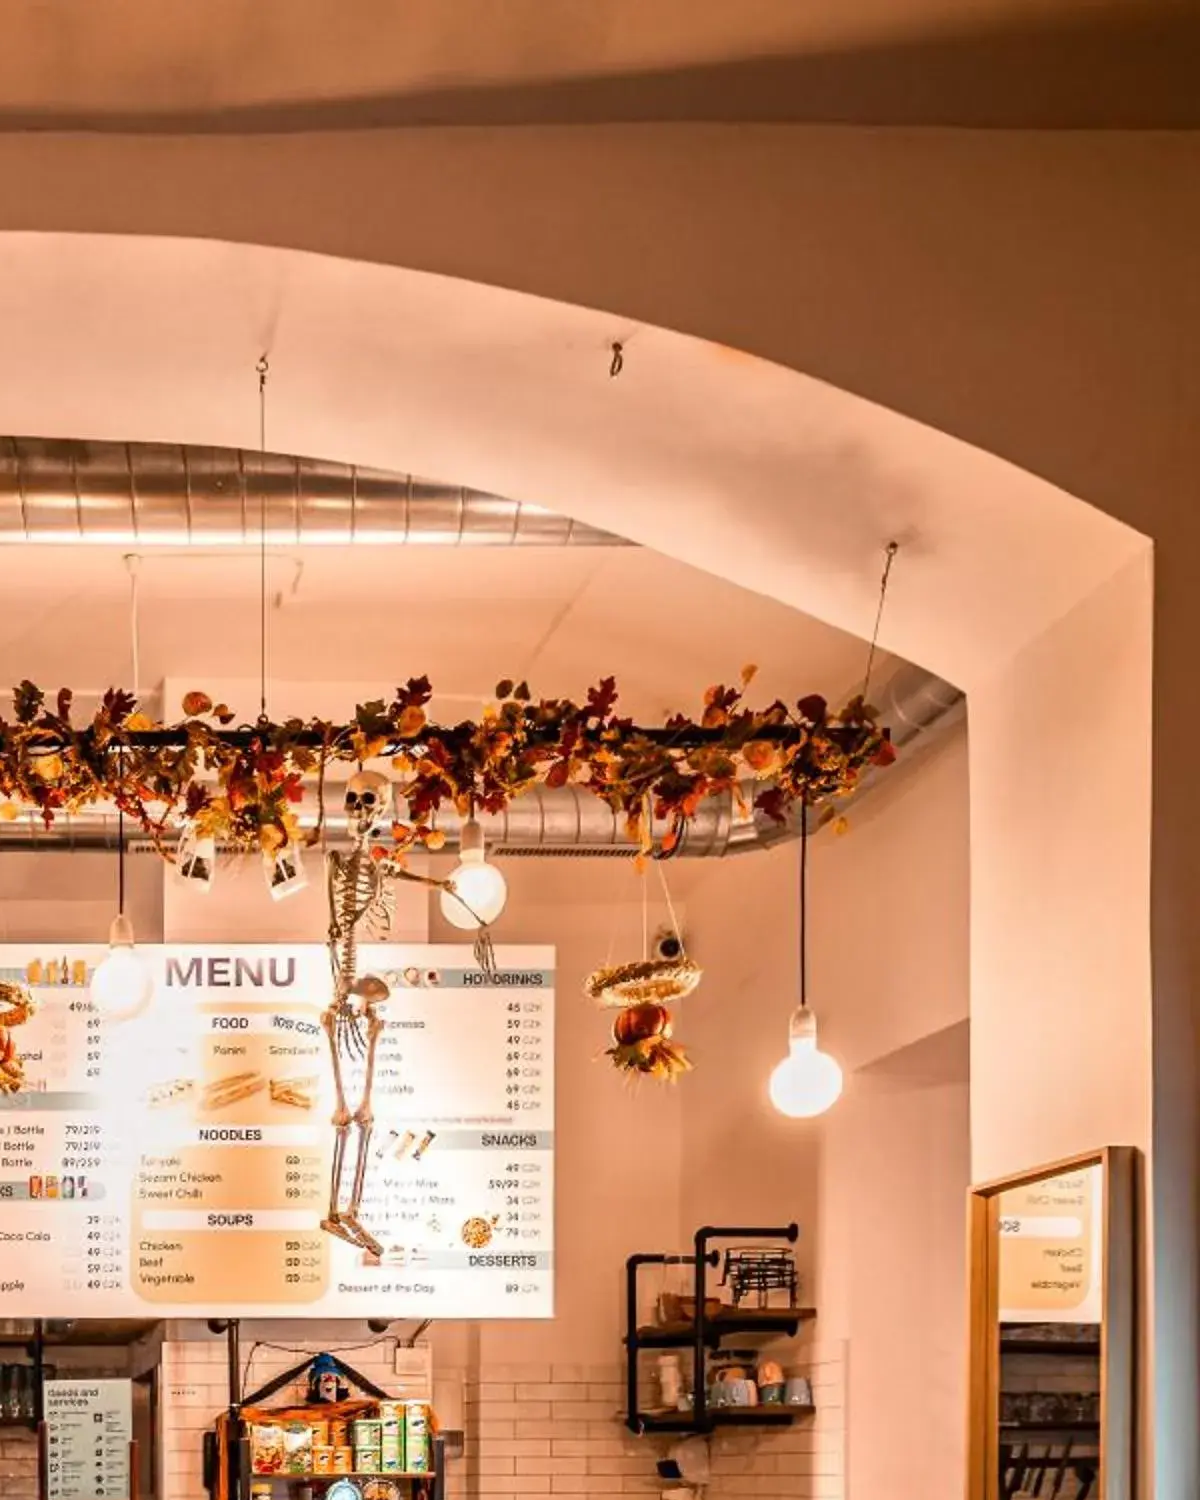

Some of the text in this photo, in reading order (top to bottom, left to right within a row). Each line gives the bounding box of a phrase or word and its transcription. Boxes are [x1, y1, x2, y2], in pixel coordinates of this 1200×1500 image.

[165, 957, 296, 987] MENU
[494, 974, 543, 986] DRINKS
[212, 1018, 249, 1029] FOOD
[506, 1019, 521, 1029] 59
[506, 1035, 521, 1045] 49
[13, 1124, 45, 1136] Bottle
[199, 1129, 263, 1141] NOODLES
[3, 1140, 36, 1152] Bottle
[481, 1135, 537, 1147] SNACKS
[0, 1157, 33, 1168] Bottle
[179, 1172, 223, 1184] Chicken
[207, 1215, 254, 1227] SOUPS
[25, 1231, 52, 1242] Cola
[86, 1231, 101, 1241] 49
[139, 1241, 184, 1252] Chicken
[86, 1248, 101, 1257] 49
[139, 1257, 164, 1268] Beef
[468, 1255, 537, 1267] DESSERTS
[86, 1263, 101, 1274] 59
[86, 1280, 101, 1290] 49
[139, 1273, 196, 1286] Vegetable
[337, 1282, 380, 1294] Dessert
[413, 1283, 436, 1296] Day
